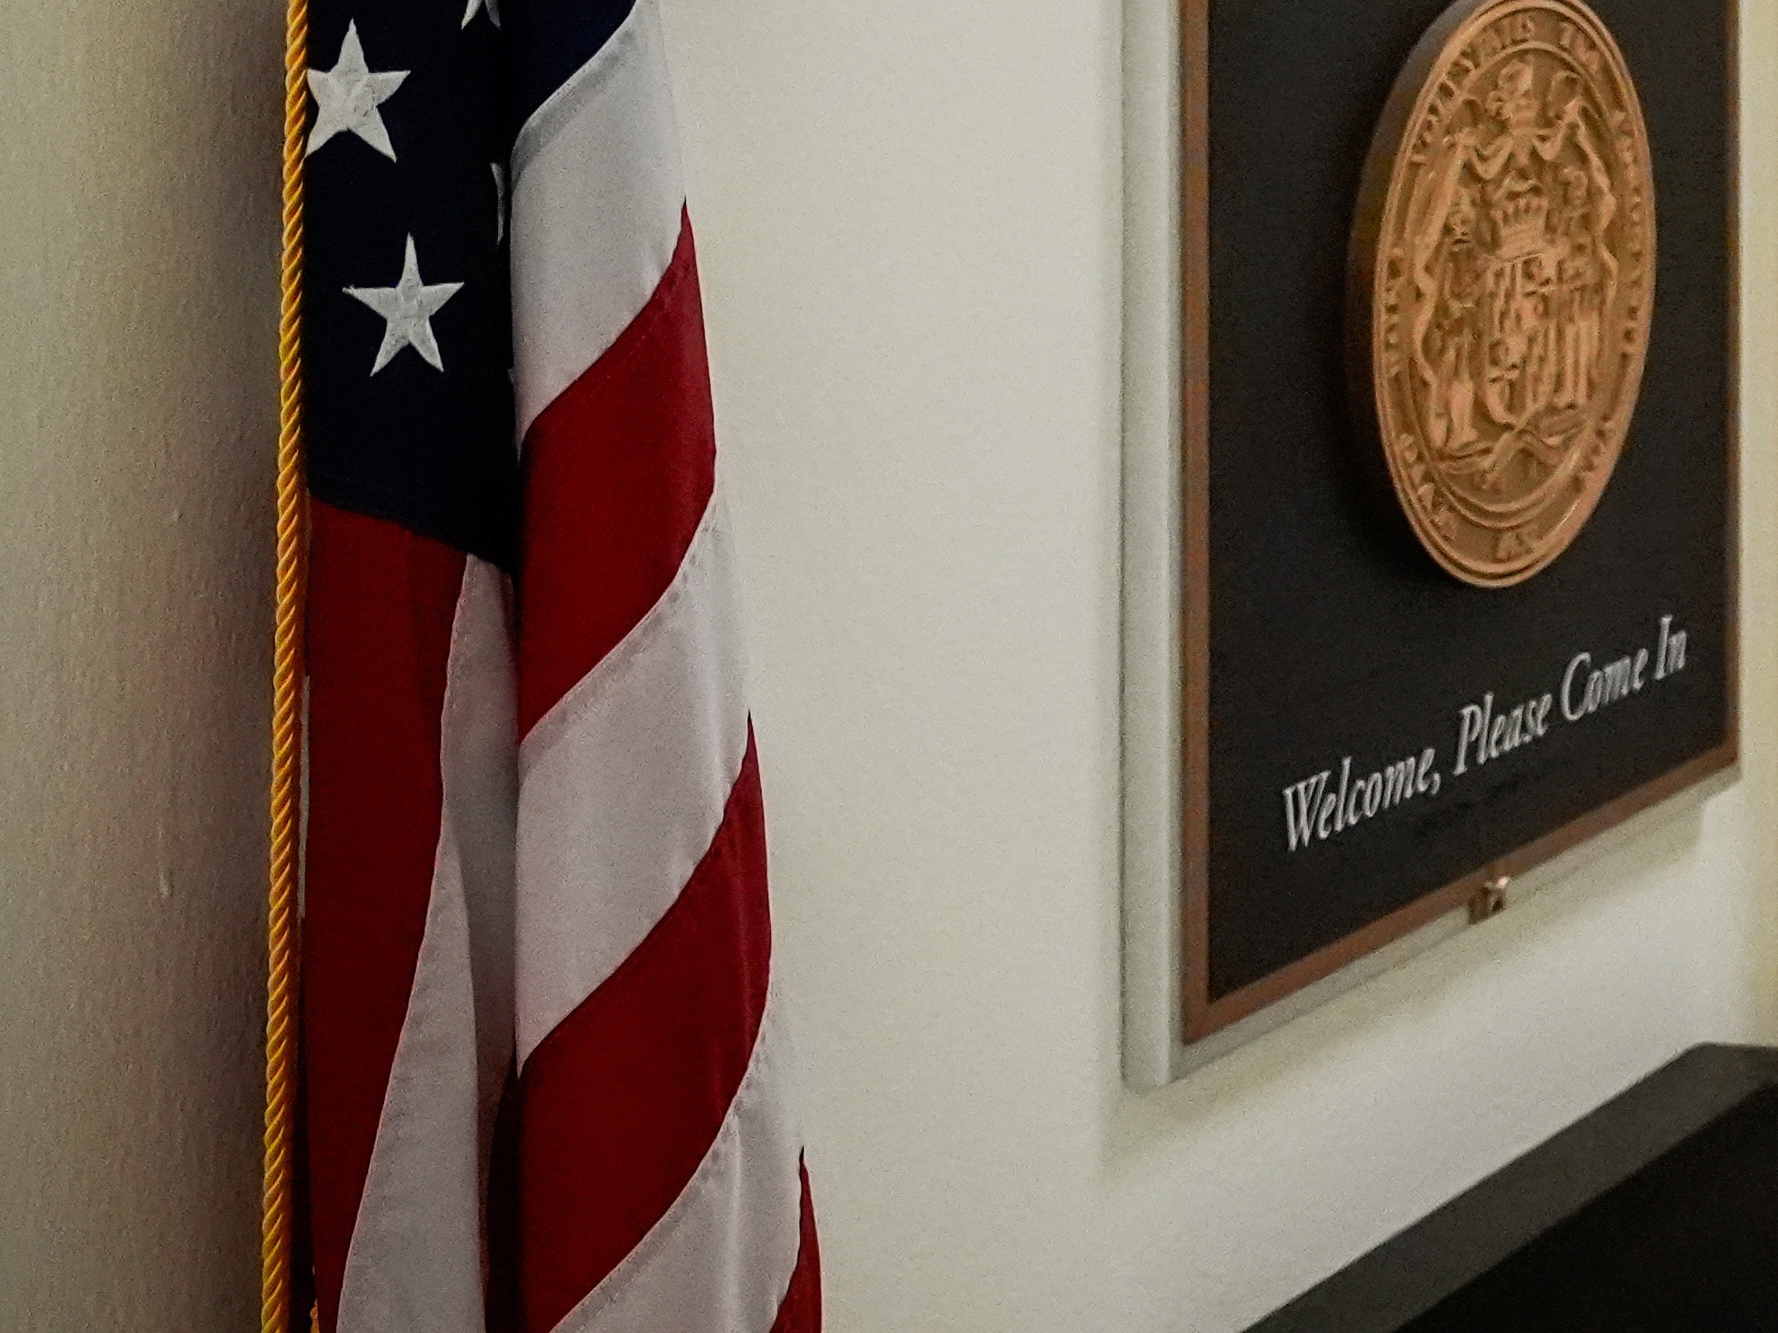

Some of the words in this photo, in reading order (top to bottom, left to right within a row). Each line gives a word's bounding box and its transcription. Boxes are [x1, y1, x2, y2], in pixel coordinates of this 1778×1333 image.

[1282, 756, 1442, 853] Welcome,
[1452, 690, 1553, 777] Please
[1560, 651, 1650, 722] Come
[1654, 614, 1688, 682] In
